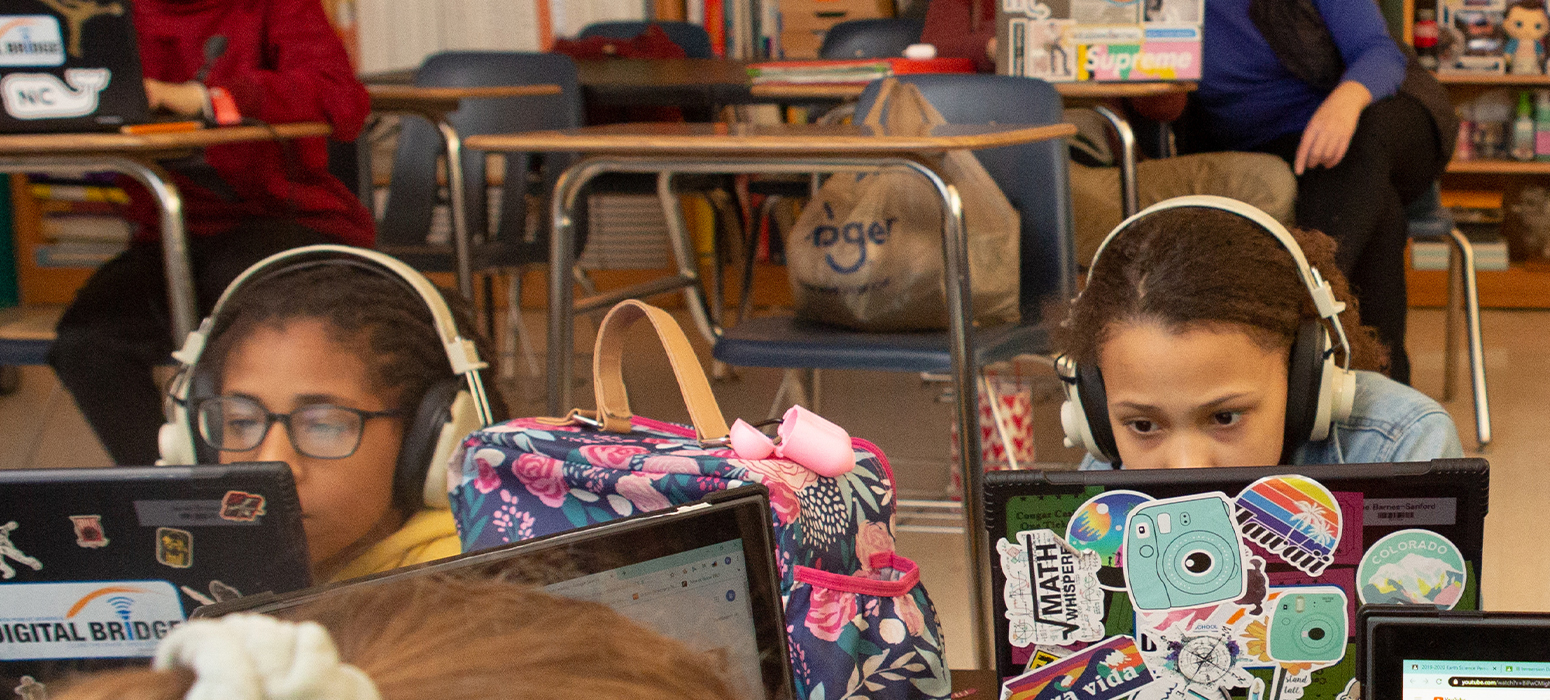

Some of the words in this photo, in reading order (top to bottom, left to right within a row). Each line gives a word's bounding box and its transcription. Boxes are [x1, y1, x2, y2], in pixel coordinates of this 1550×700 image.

[1084, 45, 1193, 77] Supreme
[18, 87, 54, 105] NC
[1372, 502, 1436, 511] Barnes-Sanford
[1371, 540, 1448, 565] COLORADO
[1035, 543, 1063, 616] MATH
[0, 622, 86, 643] IGITAL
[1082, 665, 1140, 696] vida
[1284, 685, 1300, 694] tall
[1285, 675, 1308, 683] stand
